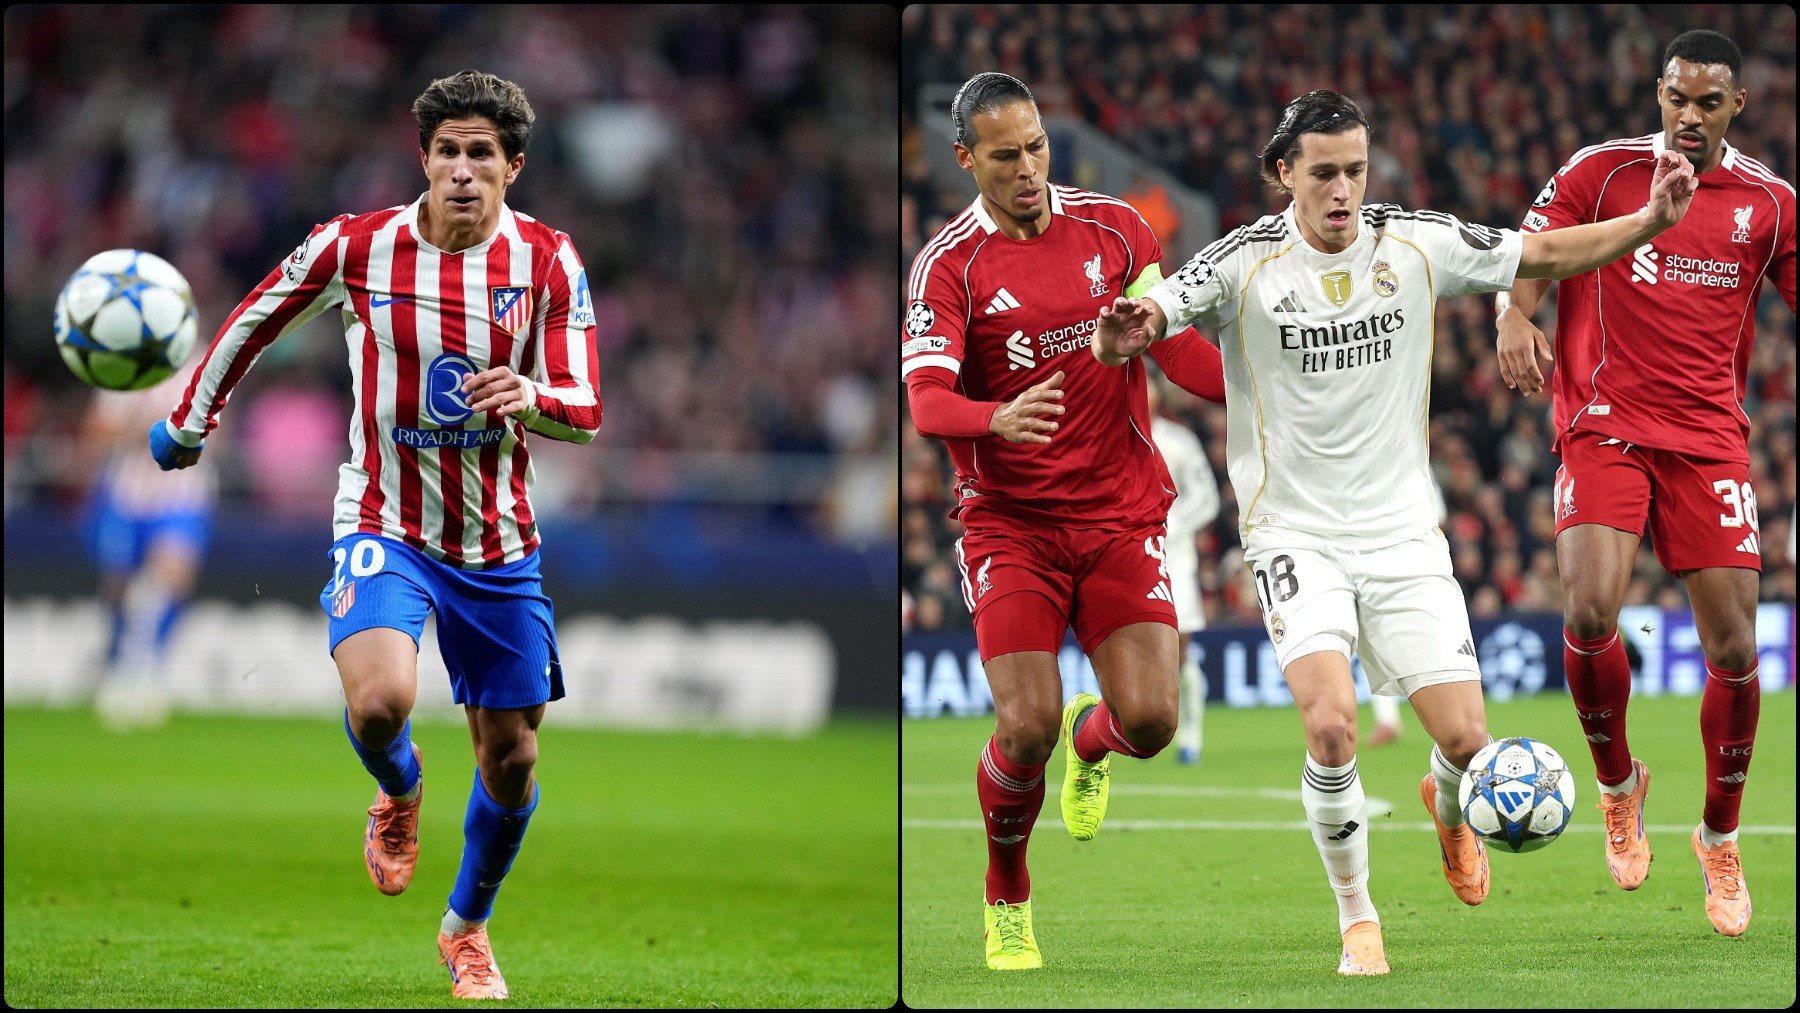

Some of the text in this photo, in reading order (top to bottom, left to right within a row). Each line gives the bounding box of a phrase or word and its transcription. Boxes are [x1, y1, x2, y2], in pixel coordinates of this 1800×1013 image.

[1664, 268, 1740, 288] chartered
[1665, 254, 1740, 275] standard
[575, 311, 595, 323] Kra
[1279, 308, 1405, 350] Emirates
[1039, 317, 1100, 346] standa
[1041, 334, 1093, 359] charte
[1302, 338, 1392, 373] FLY BETTER
[398, 428, 503, 446] RIYADH AIR
[1713, 479, 1759, 532] 38
[327, 539, 386, 597] 20
[1255, 554, 1299, 612] 18
[1719, 745, 1752, 757] LFC
